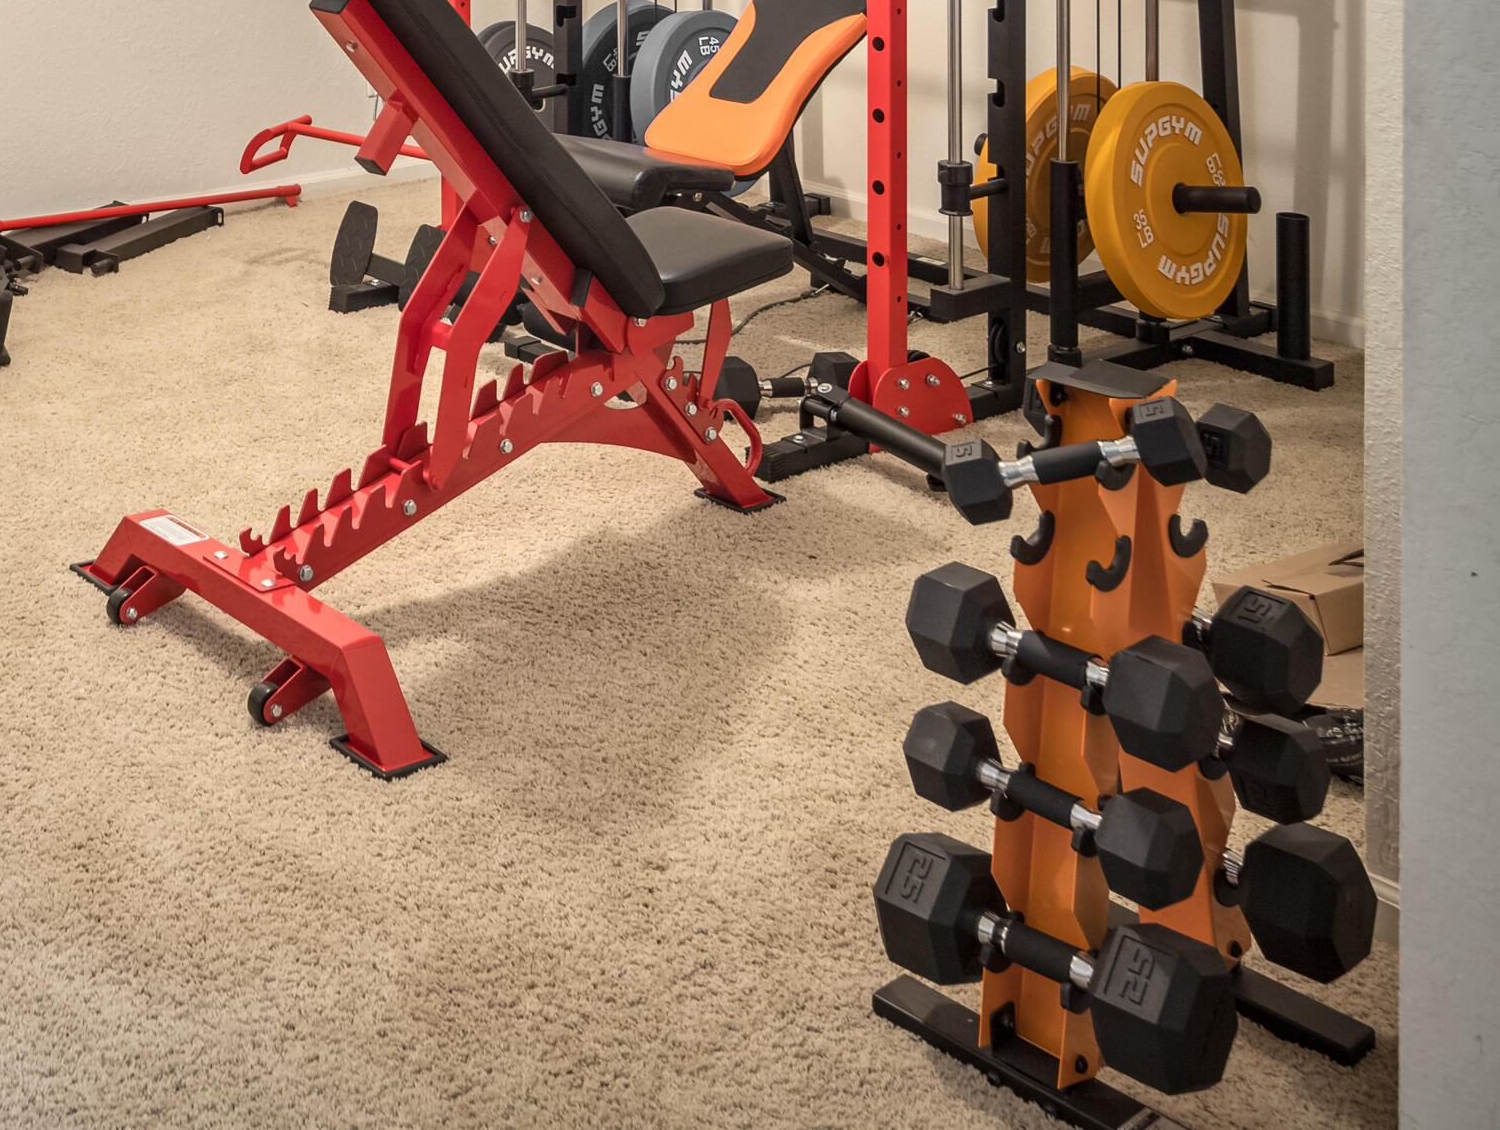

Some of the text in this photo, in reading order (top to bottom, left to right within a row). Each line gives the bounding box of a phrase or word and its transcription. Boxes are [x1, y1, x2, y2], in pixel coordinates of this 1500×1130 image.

[1130, 114, 1203, 188] SUPGYM
[1133, 209, 1147, 230] 35
[1136, 225, 1154, 249] LB
[1157, 213, 1229, 286] SUPGYM
[1119, 947, 1155, 1006] 25
